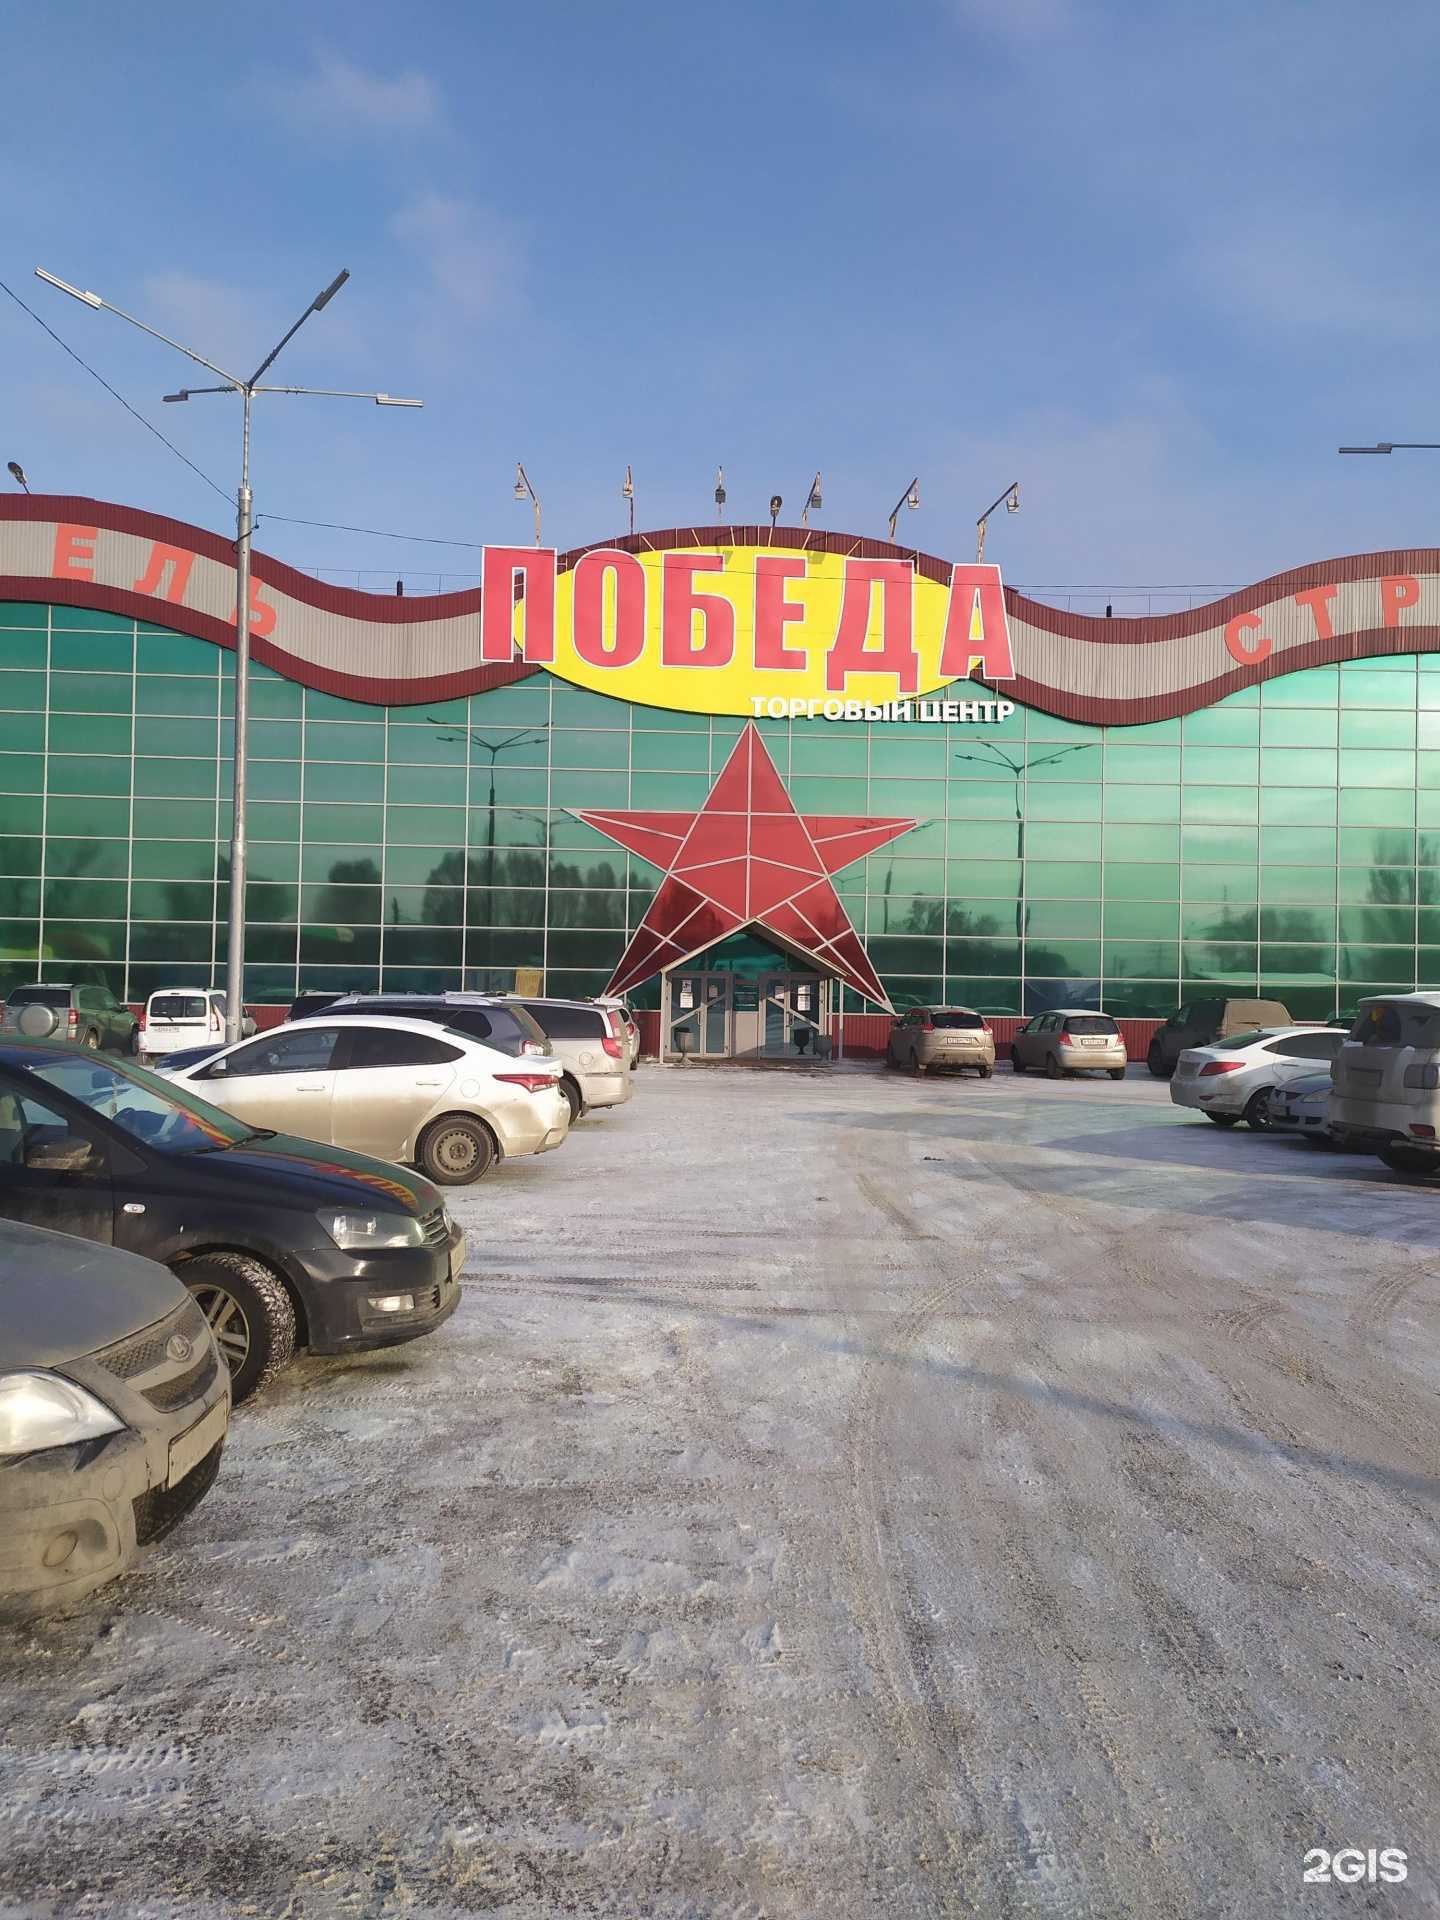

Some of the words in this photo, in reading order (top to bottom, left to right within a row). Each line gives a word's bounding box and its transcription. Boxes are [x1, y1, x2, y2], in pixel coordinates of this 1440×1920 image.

[481, 545, 1016, 694] ПОБЕДА
[1224, 575, 1420, 665] СТР
[750, 696, 911, 721] ТОРГОВЫЙ
[919, 700, 1016, 723] ЦЕНТР
